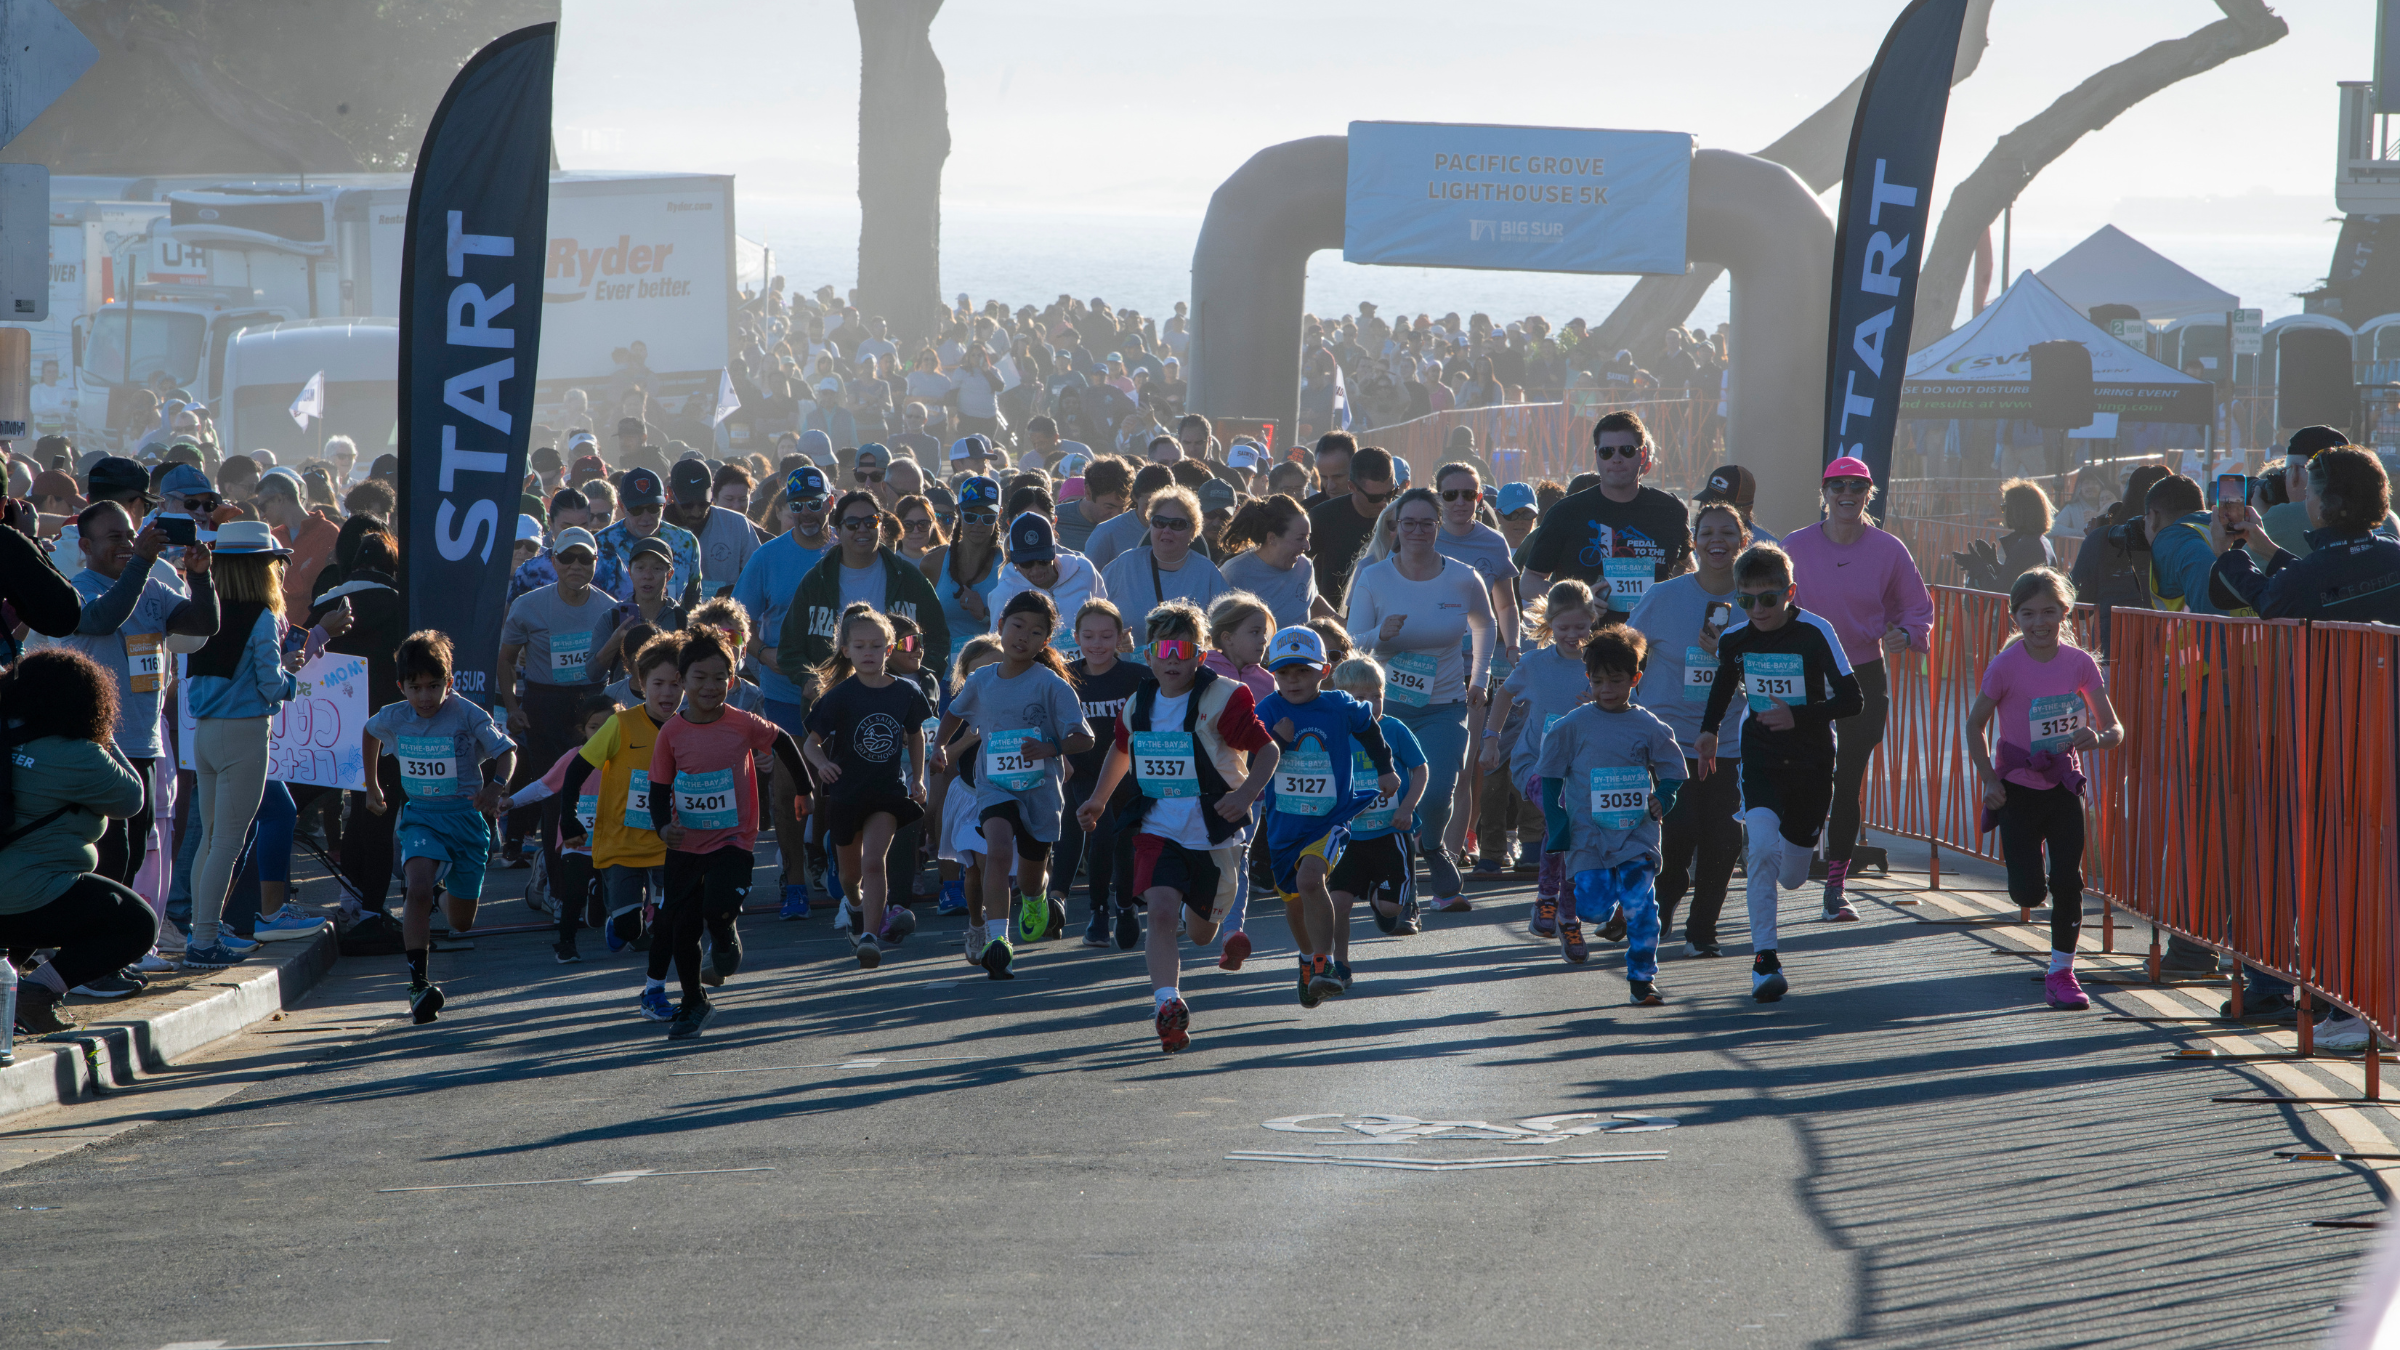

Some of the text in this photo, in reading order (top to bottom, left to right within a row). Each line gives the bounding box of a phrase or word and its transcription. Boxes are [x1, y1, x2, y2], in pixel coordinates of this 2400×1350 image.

[1434, 153, 1605, 177] PACIFIC GROVE
[1427, 181, 1608, 205] LIGHTHOUSE 5K
[666, 201, 713, 213] Ryder.com
[1500, 220, 1564, 236] BIG SUR
[546, 235, 674, 287] Ryder
[595, 276, 691, 301] Ever better.
[2235, 310, 2242, 321] 2
[2114, 321, 2143, 334] 2 HOUR
[434, 210, 515, 566] START
[1922, 385, 1942, 395] DO
[1944, 385, 1973, 395] NOT
[1976, 385, 2030, 396] DISTURB
[2137, 388, 2180, 399] EVENT
[1923, 399, 1970, 411] results
[1974, 400, 1995, 411] at
[1626, 539, 1658, 548] PEDAL
[1634, 547, 1666, 556] TO THE
[1605, 564, 1642, 572] BY-THE-BAY
[1616, 579, 1643, 593] 3111
[1276, 631, 1316, 652] WARRIORS
[1747, 660, 1799, 669] BY-THE-BAY 3K
[1390, 670, 1424, 690] 3194
[1756, 678, 1792, 694] 3131
[860, 715, 899, 735] ALL SAINTS
[2041, 715, 2078, 736] 3132
[400, 743, 451, 752] BY-THE-BAY 3K
[856, 743, 896, 760] DAY SCHOOL
[1137, 740, 1189, 749] BY-THE-BAY 3K
[407, 760, 446, 776] 3310
[1144, 759, 1185, 776] 3337
[677, 778, 720, 789] BY-THE-BAY
[1285, 776, 1327, 794] 3127
[1593, 773, 1646, 783] BY-THE-BAY 3K
[684, 795, 726, 811] 3401
[1599, 791, 1643, 809] 3039
